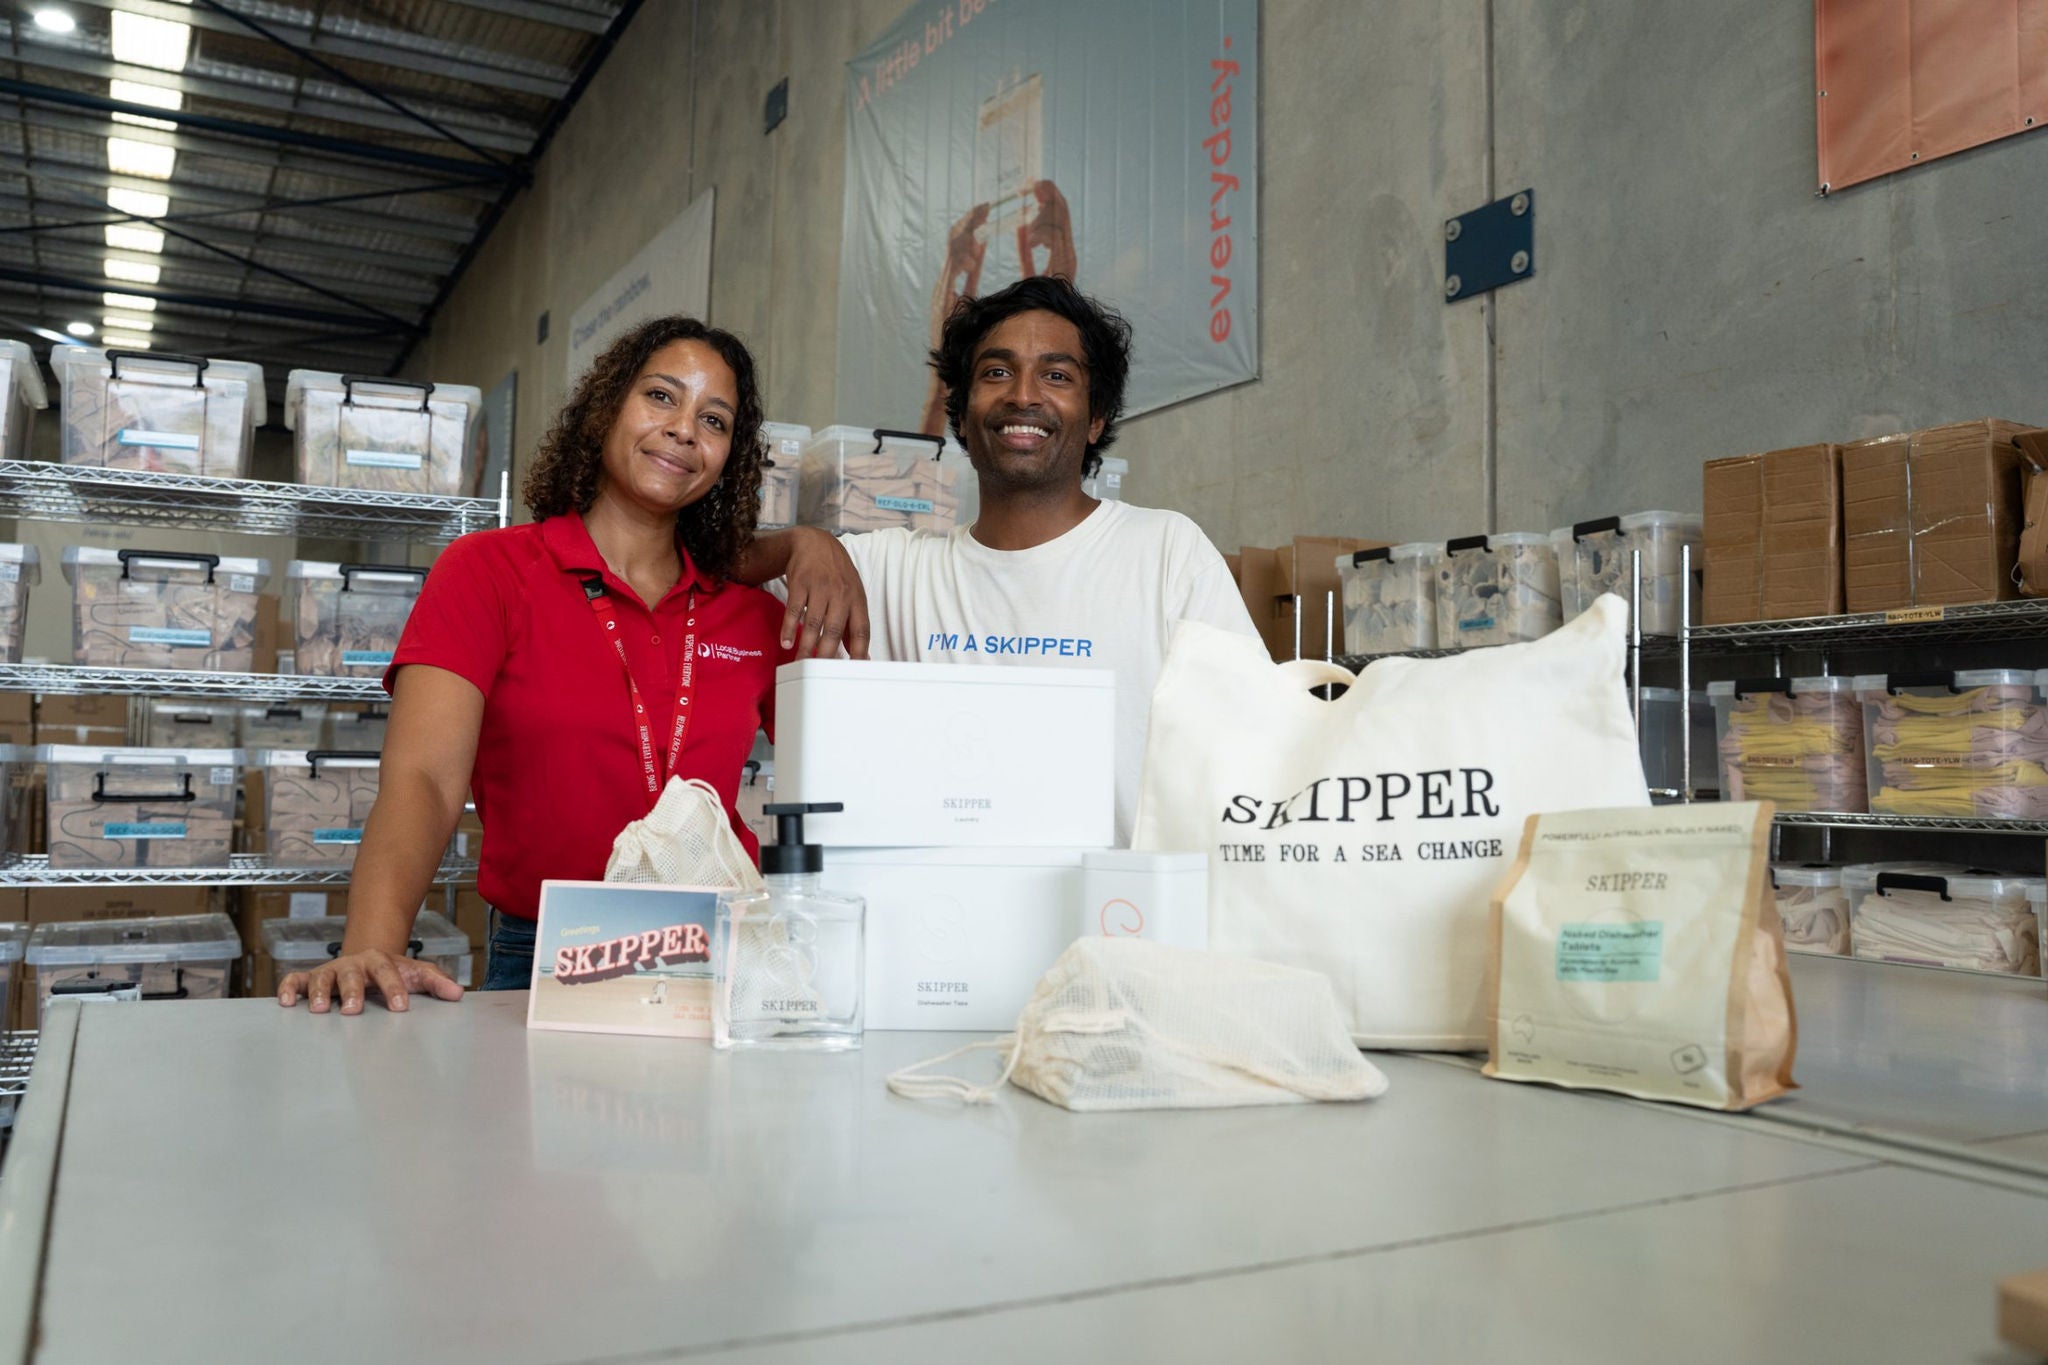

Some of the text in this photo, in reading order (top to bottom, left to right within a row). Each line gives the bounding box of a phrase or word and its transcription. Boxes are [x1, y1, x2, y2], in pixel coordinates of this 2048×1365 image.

[875, 39, 921, 97] little
[925, 5, 954, 55] bit
[1202, 36, 1240, 343] everyday.
[928, 633, 1093, 657] I'M A SKIPPER
[682, 634, 695, 688] RESPECTING EVERYONE
[675, 715, 686, 737] HELPING
[645, 760, 654, 774] SAFE
[648, 775, 657, 792] BEING
[943, 798, 992, 809] SKIPPER
[1221, 768, 1500, 830] SKIPPER
[1220, 839, 1503, 862] TIME FOR A SEA CHANGE
[1585, 872, 1668, 892] SKIPPER
[554, 923, 709, 982] SKIPPER
[917, 982, 969, 993] SKIPPER
[761, 1000, 817, 1011] SKIPPER
